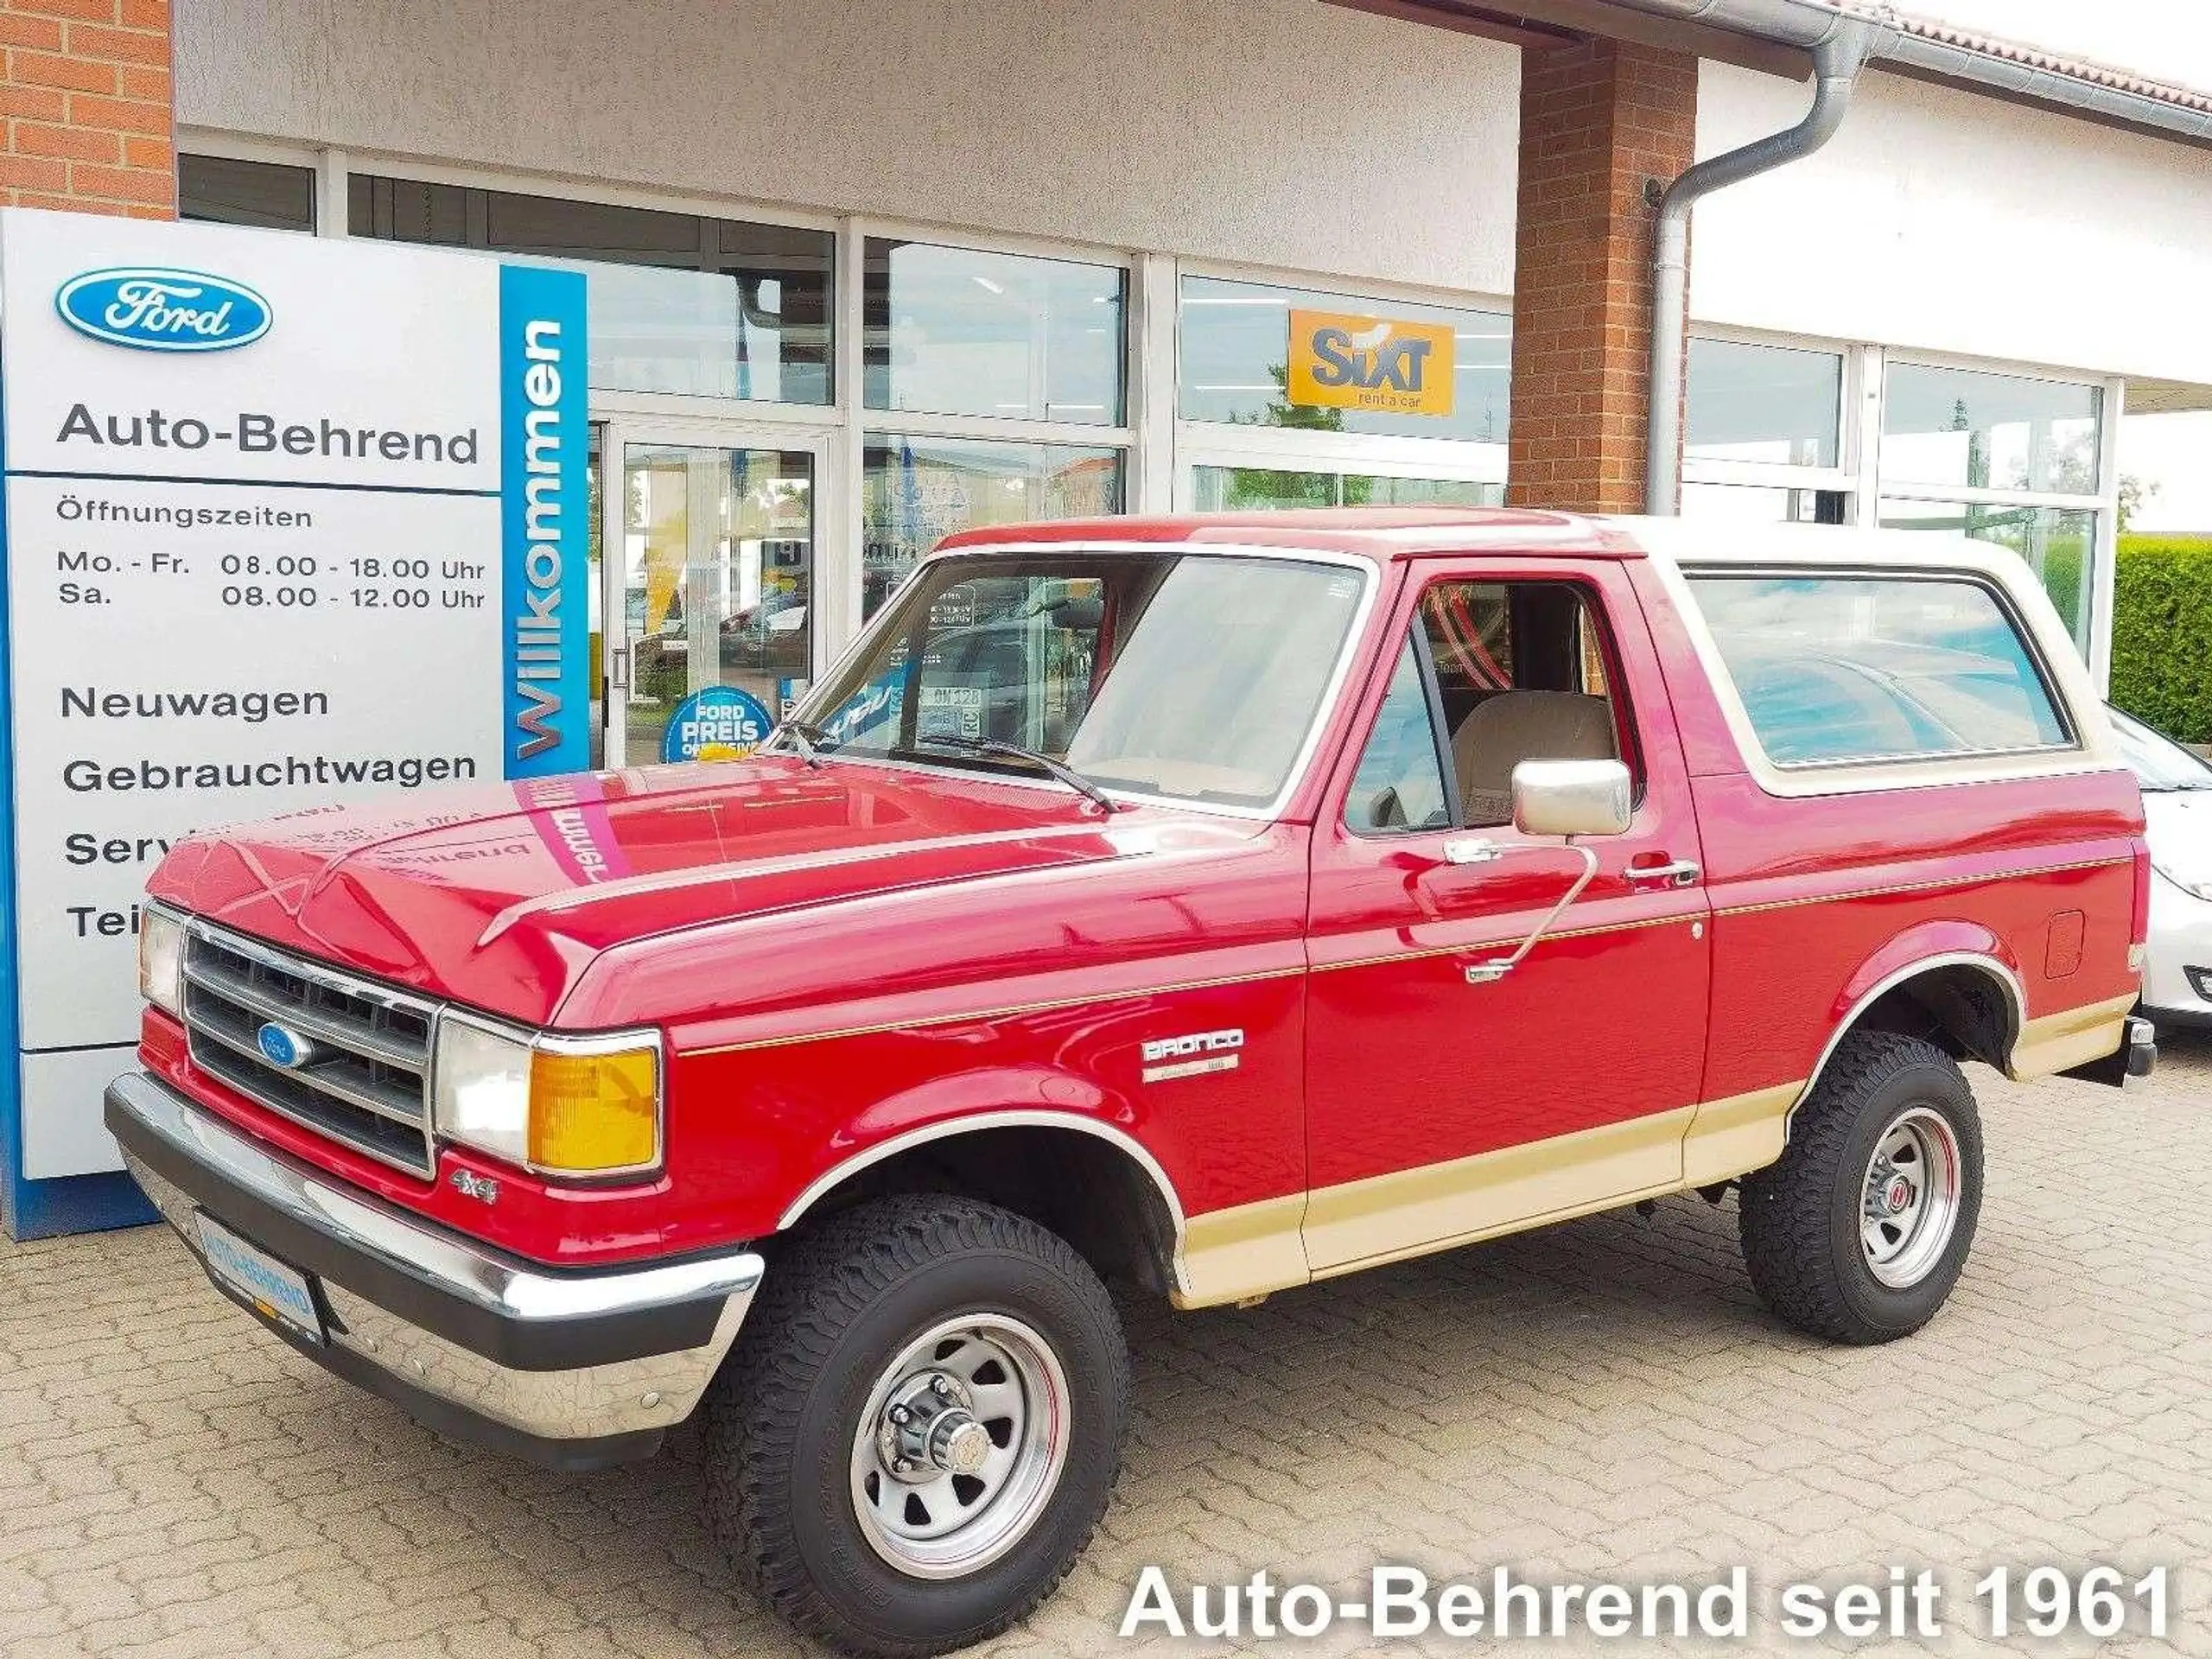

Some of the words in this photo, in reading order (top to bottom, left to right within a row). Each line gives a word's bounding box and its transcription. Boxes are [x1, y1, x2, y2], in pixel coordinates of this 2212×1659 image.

[105, 280, 233, 335] Ford
[1358, 392, 1385, 405] rent
[1399, 397, 1421, 409] car
[56, 404, 477, 465] Auto-Behrend
[56, 494, 313, 529] Öffnungszeiten
[517, 319, 562, 761] Willkommen
[57, 551, 121, 573] Mo.
[151, 553, 190, 574] Fr.
[220, 554, 317, 576] 08.00
[349, 557, 430, 579] 18.00
[442, 561, 486, 580] Uhr
[59, 582, 111, 605] Sa.
[221, 586, 317, 607] 08.00
[349, 588, 430, 608] 12.00
[442, 590, 486, 608] Uhr
[61, 687, 329, 723] Neuwagen
[695, 704, 745, 721] FORD
[681, 720, 759, 742] PREIS
[63, 755, 476, 792] Gebrauchtwagen
[1141, 1028, 1244, 1062] BRONCO
